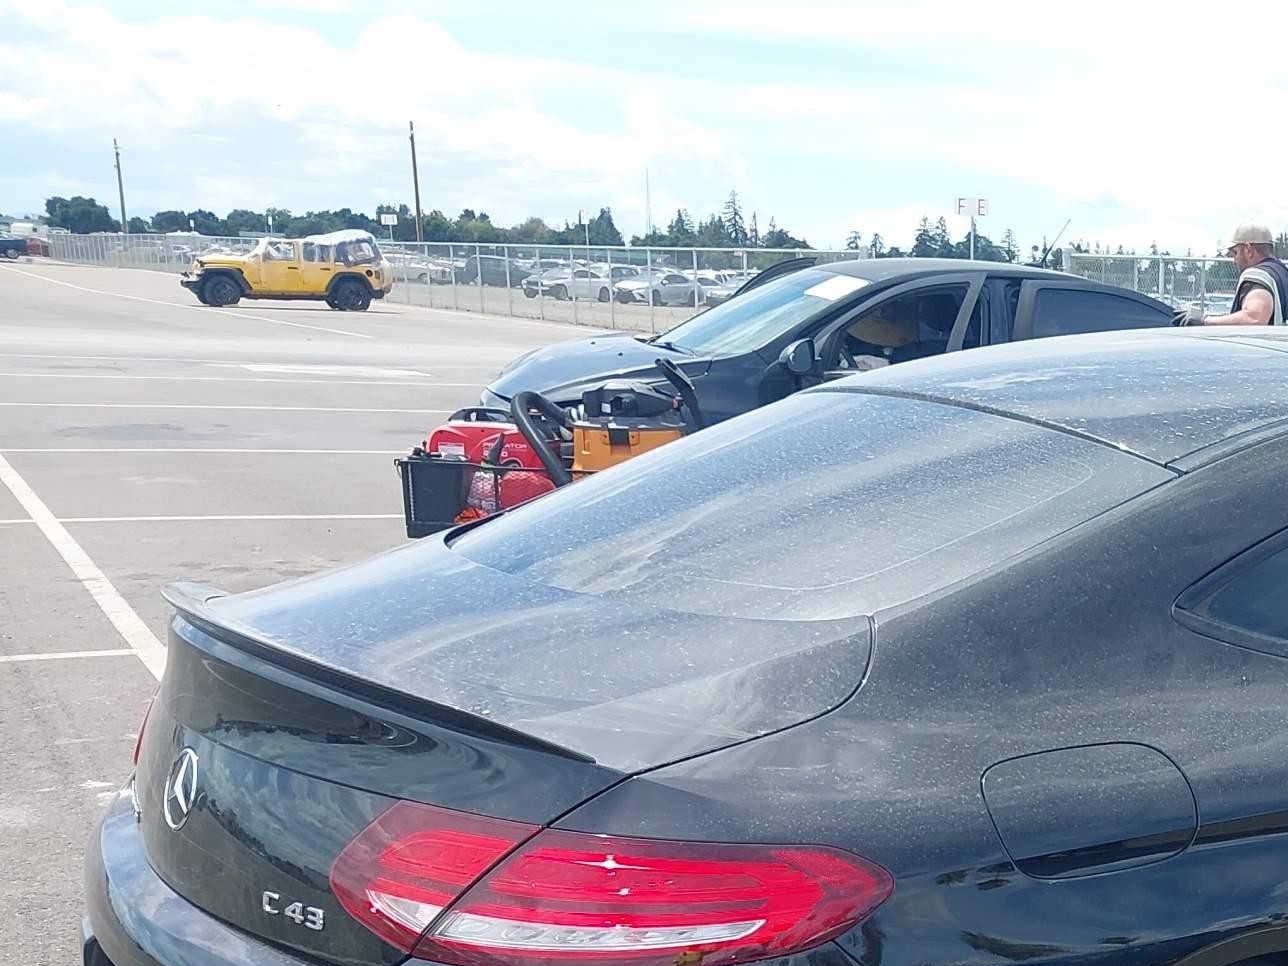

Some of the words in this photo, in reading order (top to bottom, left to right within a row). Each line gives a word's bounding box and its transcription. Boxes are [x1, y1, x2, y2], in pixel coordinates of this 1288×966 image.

[958, 198, 967, 215] F
[978, 199, 986, 217] E
[263, 890, 280, 915] C
[284, 902, 325, 931] 43
